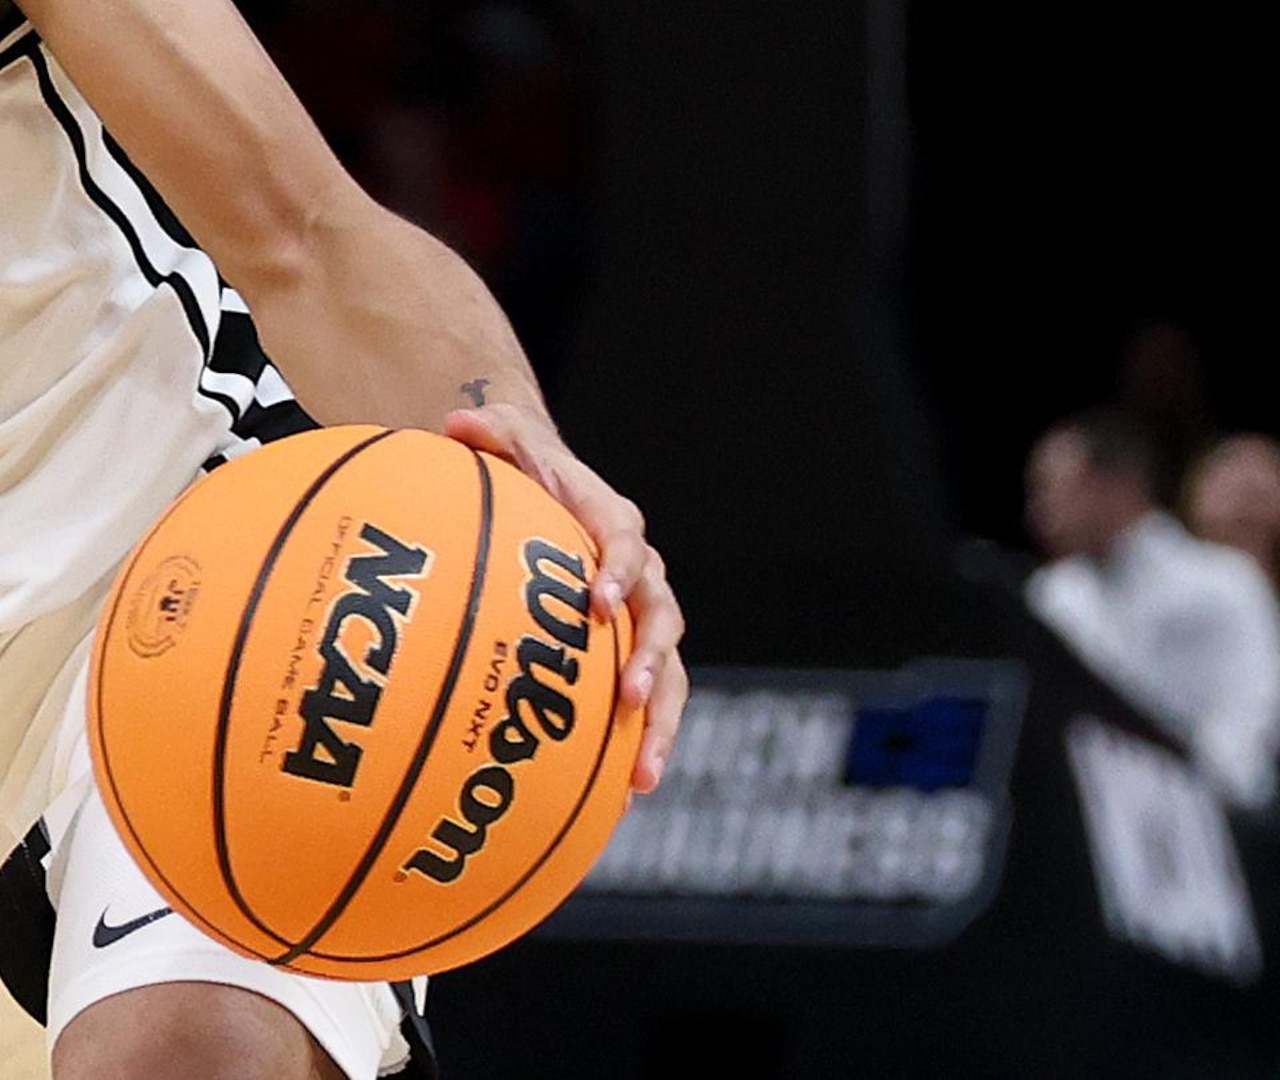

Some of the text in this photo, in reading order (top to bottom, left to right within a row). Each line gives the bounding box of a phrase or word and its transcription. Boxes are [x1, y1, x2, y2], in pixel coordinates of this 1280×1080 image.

[259, 515, 353, 764] OFFICIAL GAME BALL
[280, 520, 433, 790] NCAA
[402, 537, 592, 885] Wilson
[461, 639, 508, 754] EVO NXT
